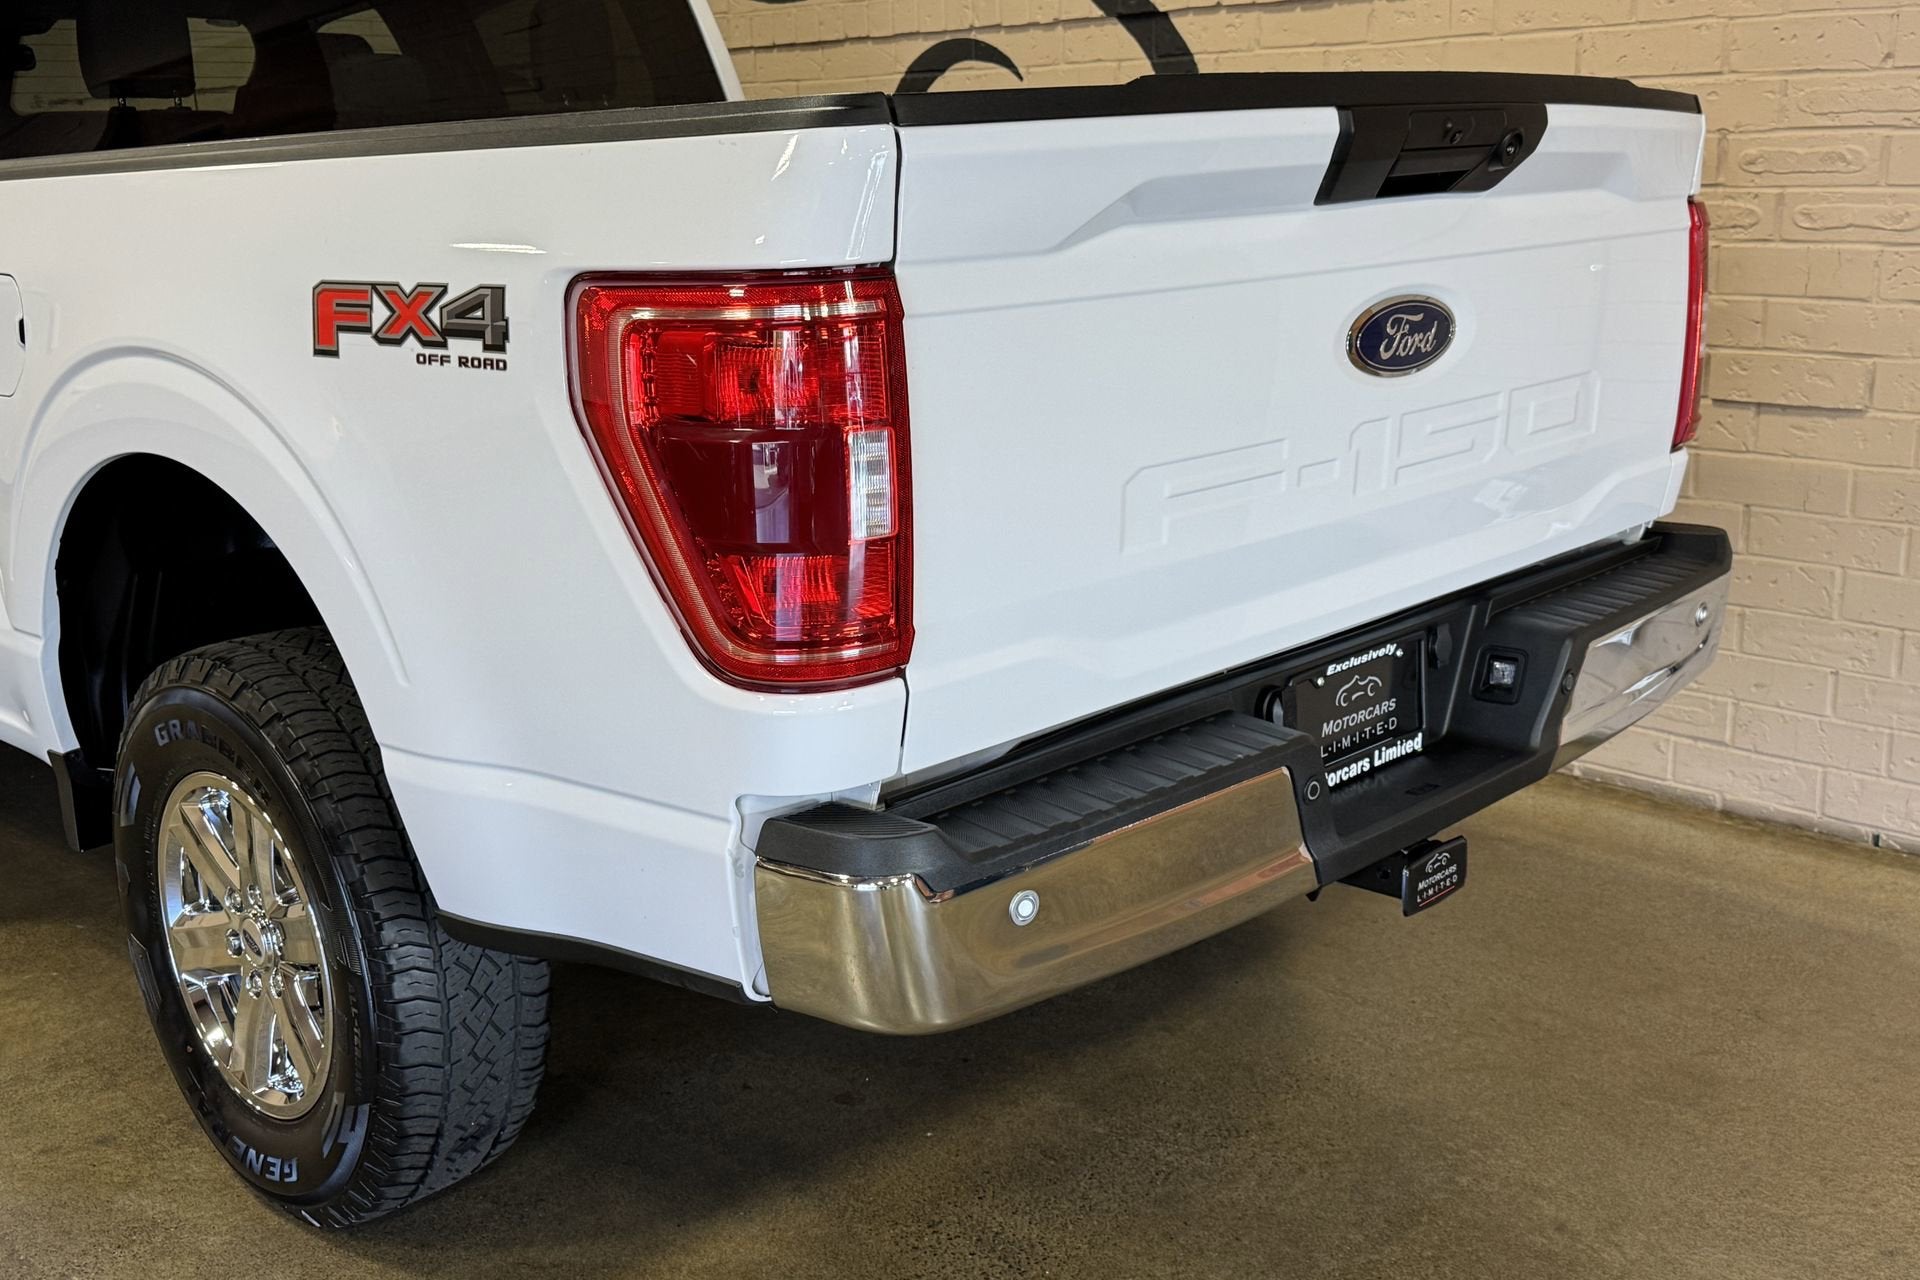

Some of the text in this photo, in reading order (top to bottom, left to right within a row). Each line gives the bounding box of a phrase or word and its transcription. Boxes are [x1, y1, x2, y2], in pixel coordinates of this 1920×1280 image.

[312, 280, 509, 358] FX4
[1379, 312, 1438, 361] Ford
[416, 353, 508, 371] OFF ROAD
[1119, 369, 1600, 557] F-150
[1326, 643, 1397, 677] Exclusively
[1321, 698, 1397, 738] MOTORCARS
[1325, 732, 1423, 787] orcars Limited
[1417, 864, 1457, 891] MOTORCARS
